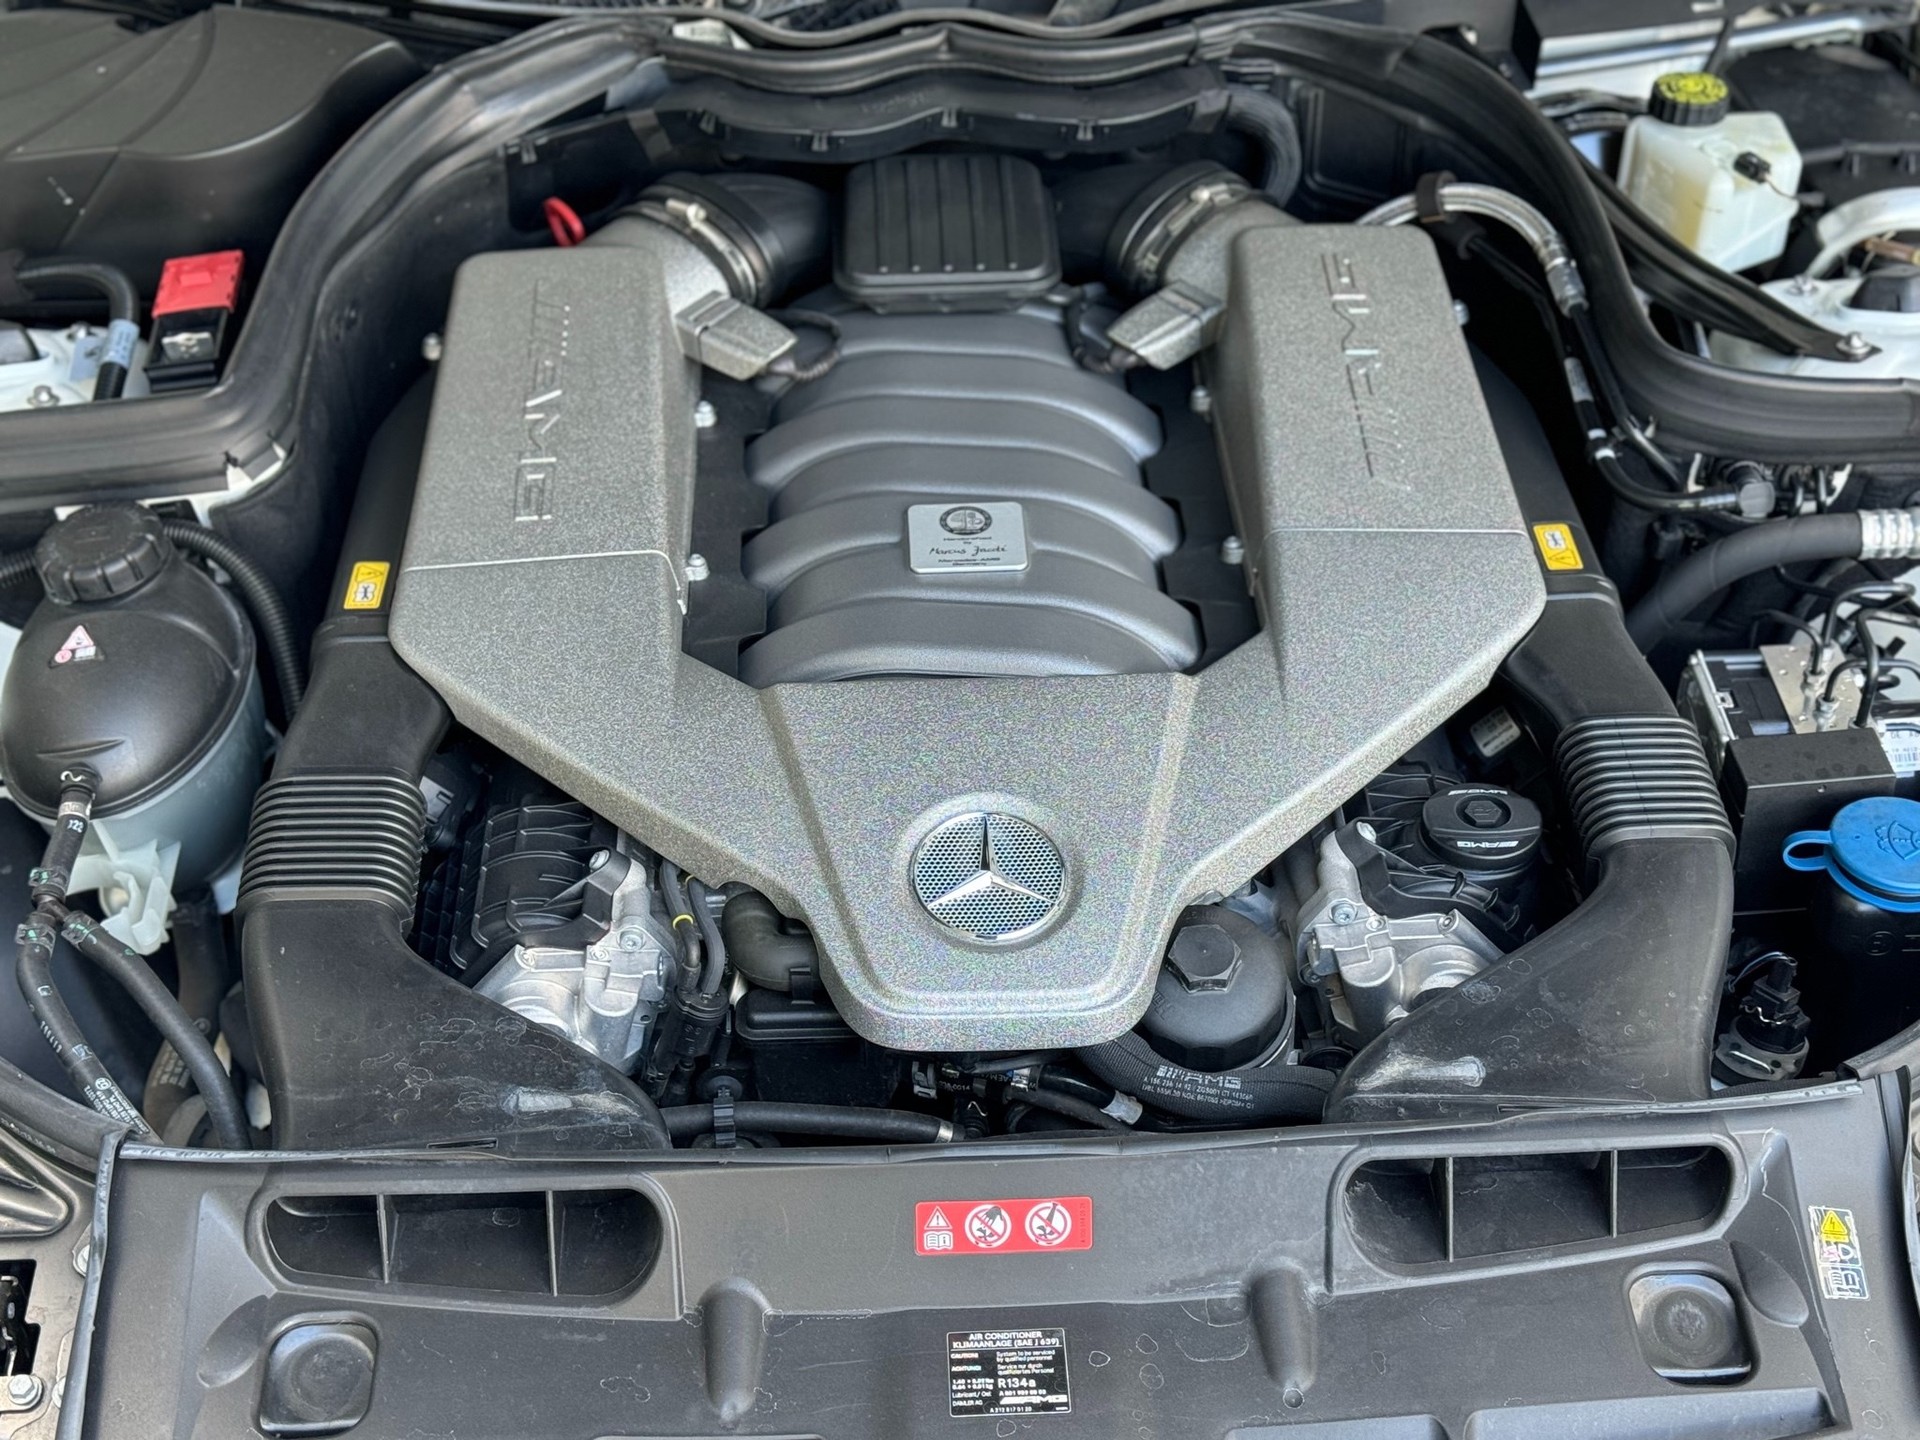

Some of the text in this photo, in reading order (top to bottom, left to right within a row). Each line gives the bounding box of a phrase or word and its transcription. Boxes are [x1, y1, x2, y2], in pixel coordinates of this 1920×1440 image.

[514, 330, 565, 521] AMG
[1176, 1068, 1241, 1089] AMG
[985, 1331, 1042, 1340] CONDITIONER
[953, 1340, 1012, 1348] KLIMAANLAGE
[1014, 1340, 1033, 1348] (SAE
[1040, 1338, 1059, 1346] 639)
[998, 1378, 1037, 1388] R134a
[1008, 1395, 1068, 1404] AMG
